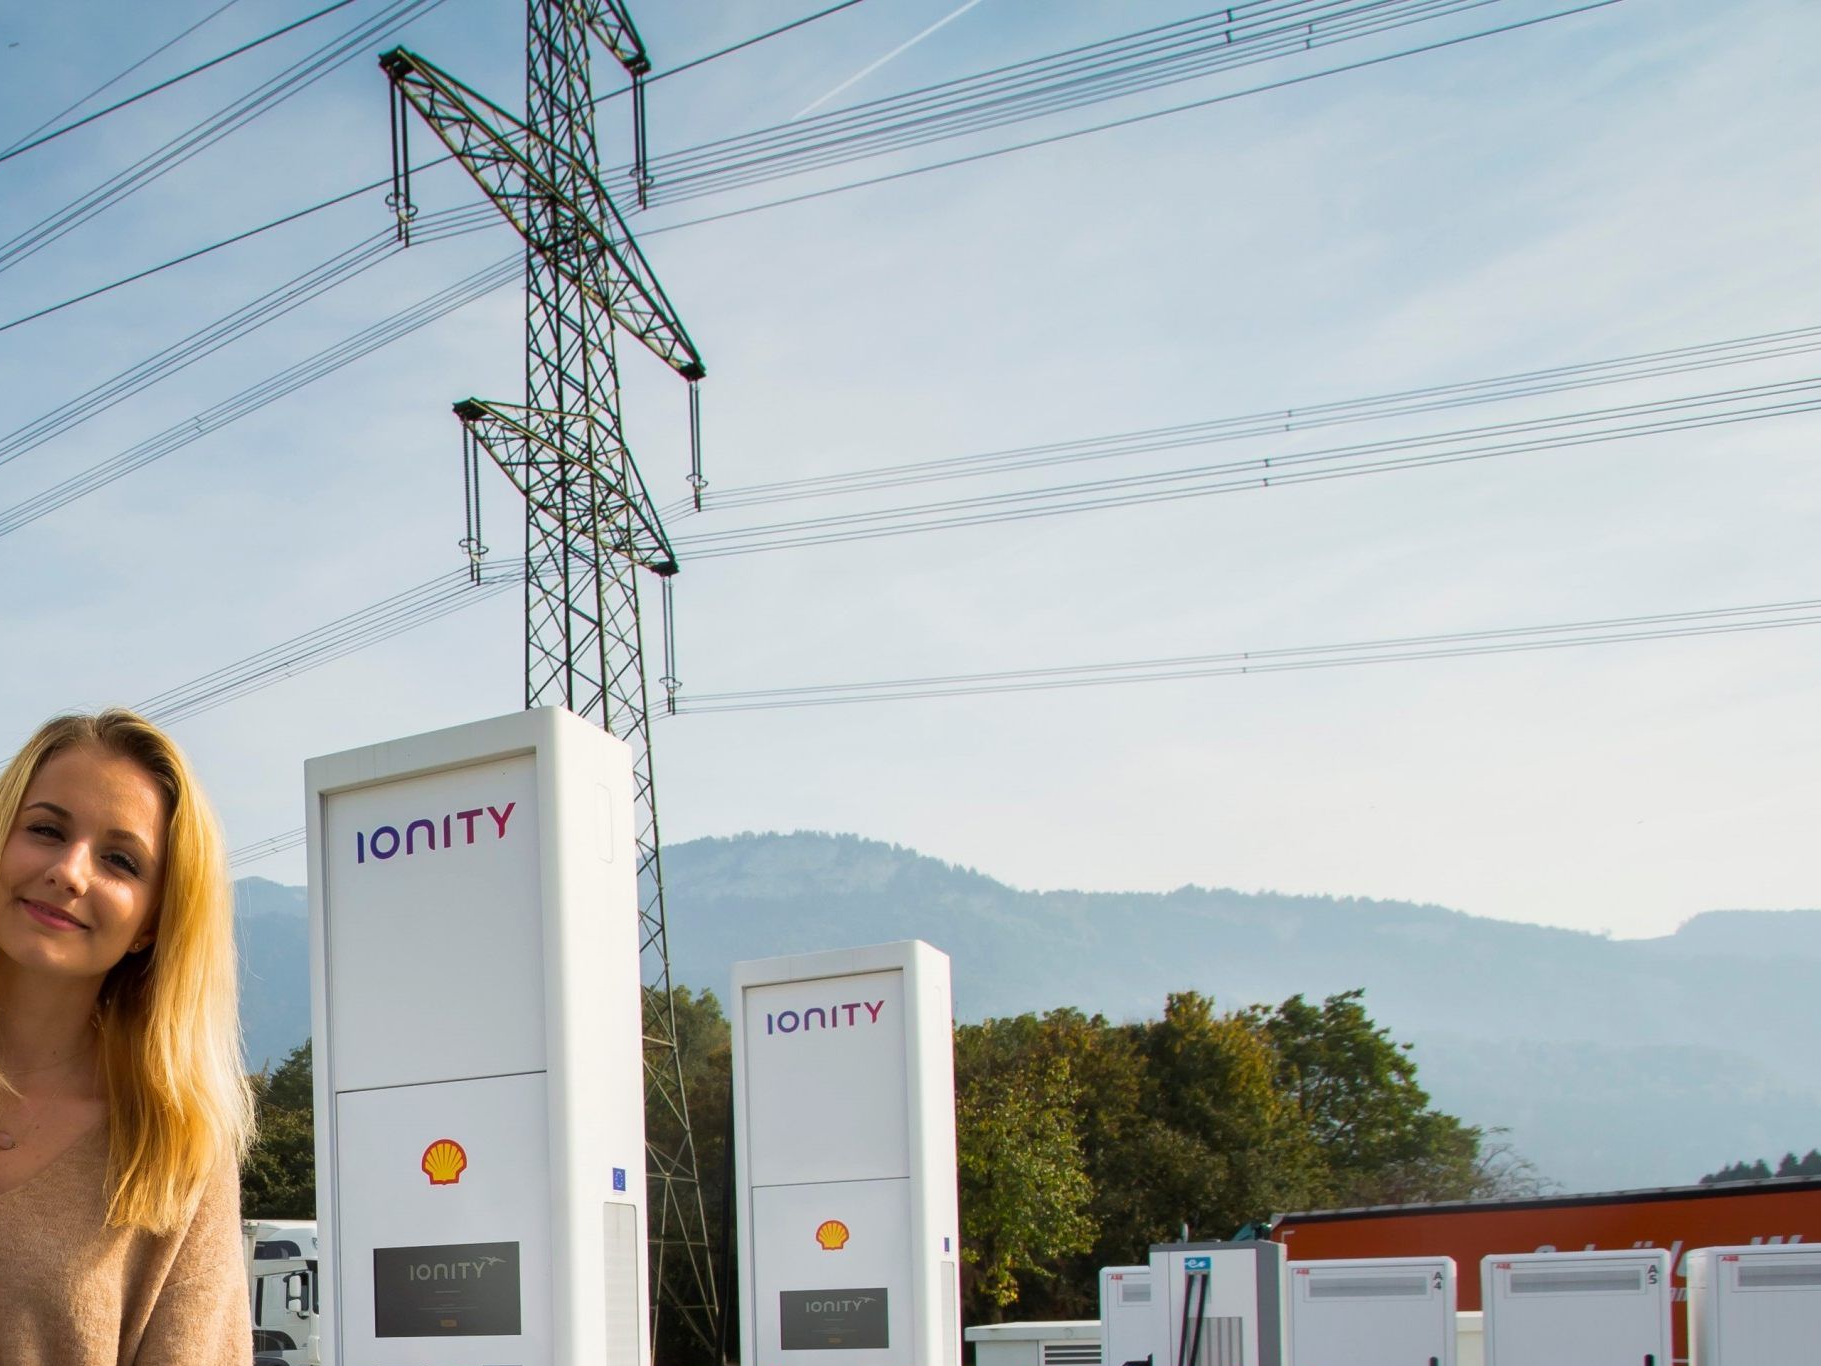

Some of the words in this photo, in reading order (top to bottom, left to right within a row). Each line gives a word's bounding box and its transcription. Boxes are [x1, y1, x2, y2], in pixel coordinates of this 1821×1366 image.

[357, 802, 516, 864] IONITY
[767, 1000, 885, 1035] IONITY
[410, 1261, 486, 1281] IONITY
[1647, 1265, 1658, 1274] A
[1433, 1272, 1443, 1281] A
[1648, 1275, 1658, 1285] 5
[1434, 1282, 1442, 1290] 4
[806, 1299, 862, 1313] IONITY
